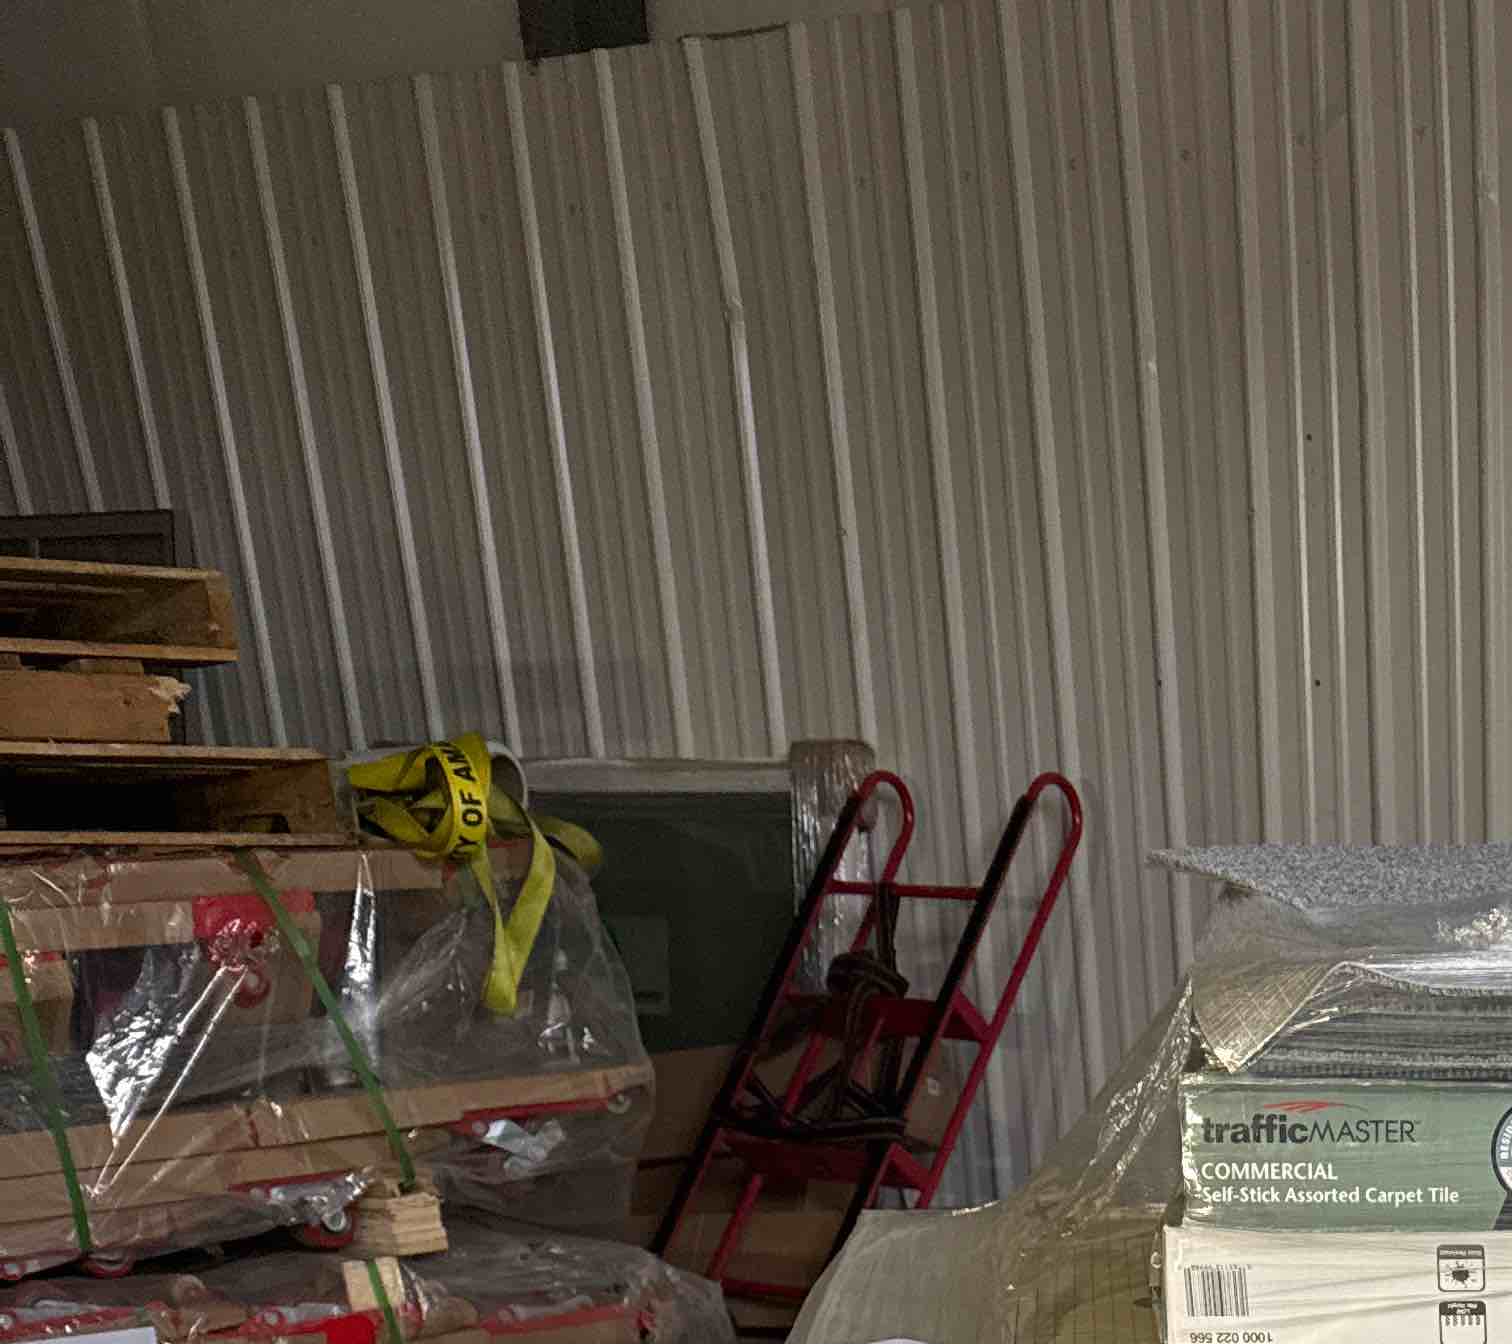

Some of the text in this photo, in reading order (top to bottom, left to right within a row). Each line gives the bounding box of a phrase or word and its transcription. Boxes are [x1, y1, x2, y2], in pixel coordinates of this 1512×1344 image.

[459, 789, 484, 827] OF
[1202, 1162, 1338, 1181] COMMERCIAL
[1201, 1186, 1459, 1208] Self-Stick Assorted Carpet Tile
[1216, 1332, 1240, 1344] 022
[1243, 1332, 1273, 1344] 1000
